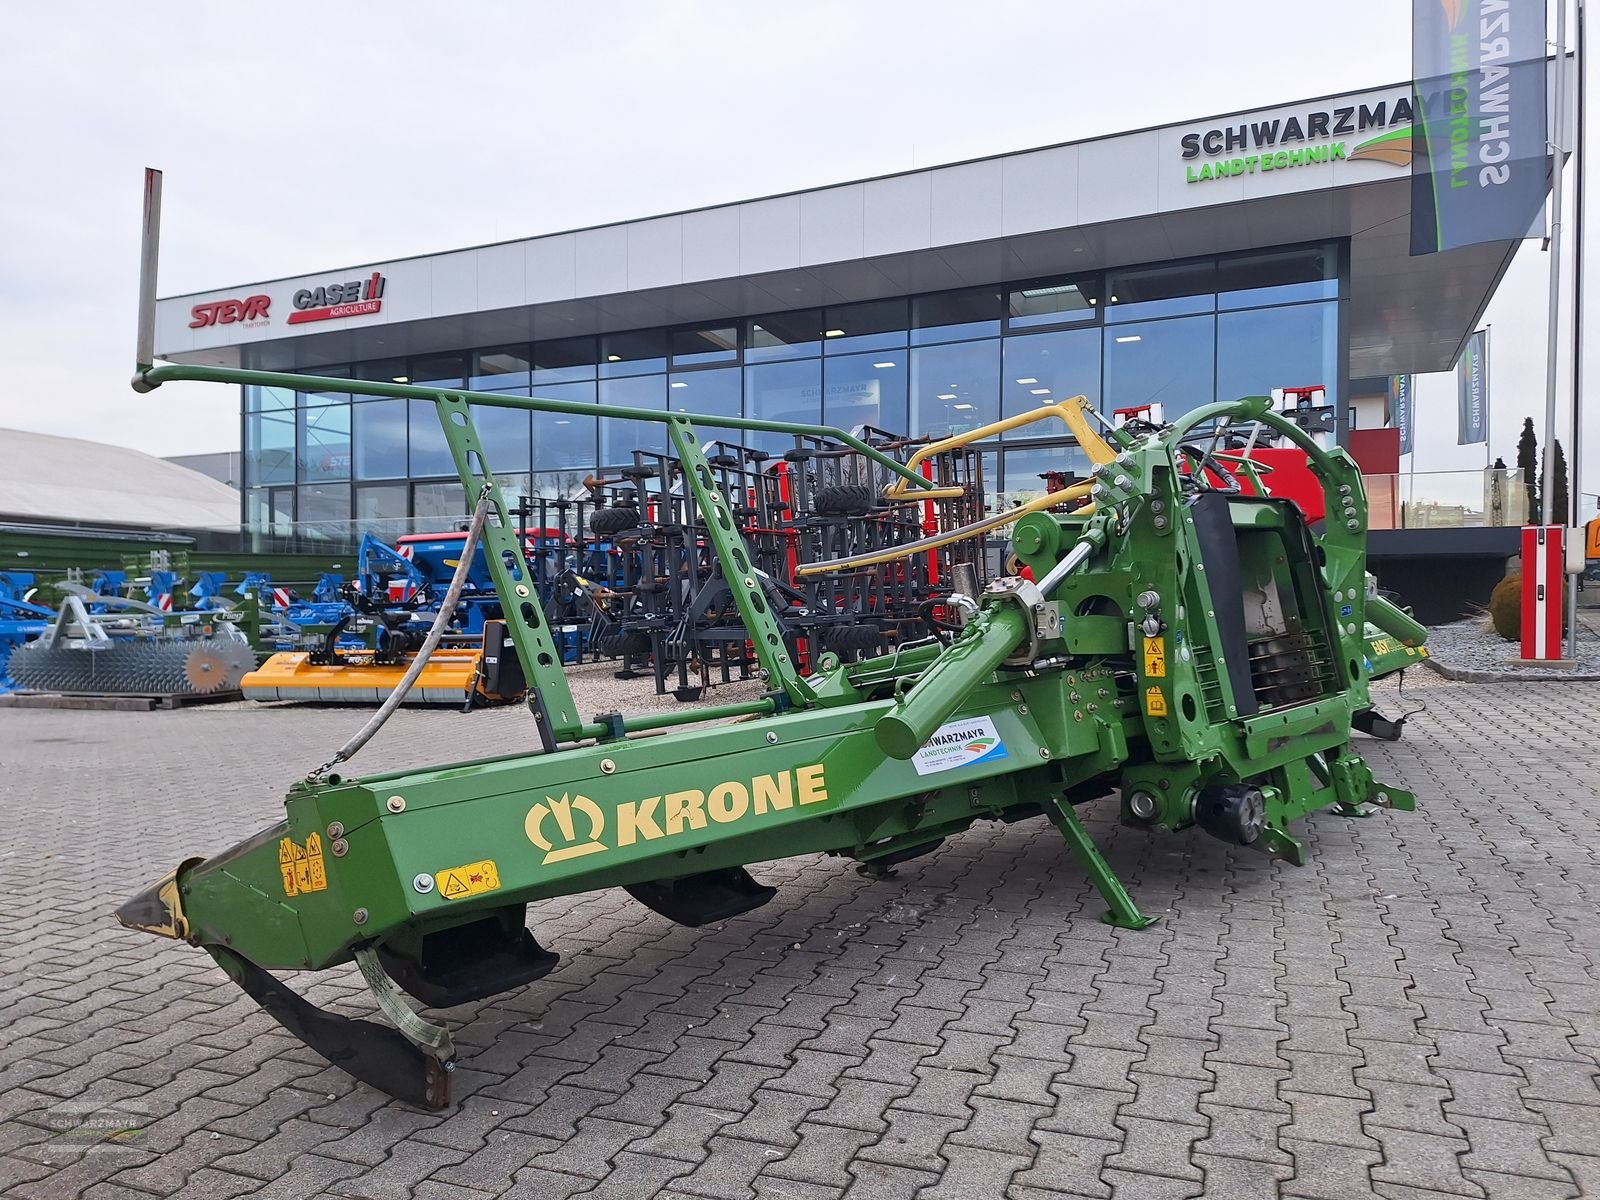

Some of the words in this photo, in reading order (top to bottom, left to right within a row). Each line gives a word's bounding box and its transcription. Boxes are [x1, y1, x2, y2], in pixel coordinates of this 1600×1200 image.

[1186, 142, 1347, 183] LANDTECHNIK
[188, 294, 271, 328] STEYR
[292, 280, 361, 310] CASE
[330, 302, 377, 316] AGRICULTURE
[920, 745, 963, 759] LANDTECHNIK
[617, 763, 828, 848] KRONE
